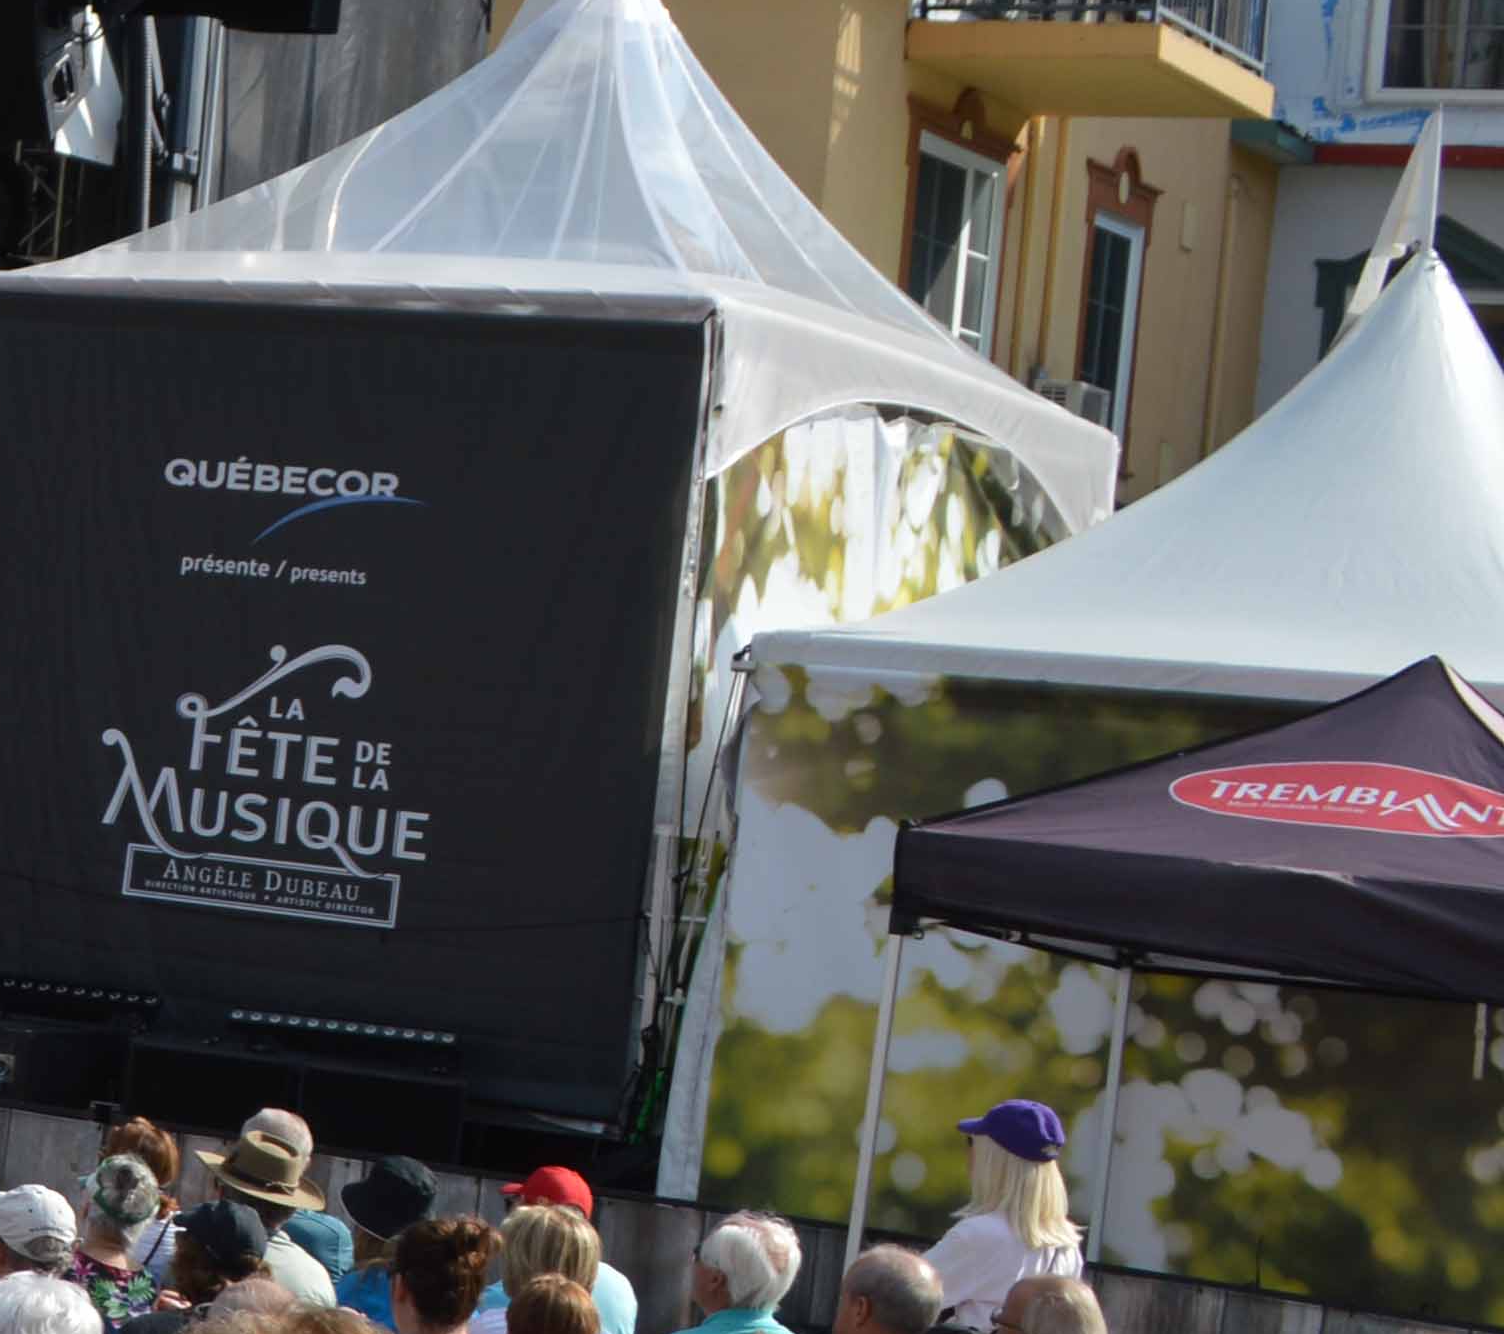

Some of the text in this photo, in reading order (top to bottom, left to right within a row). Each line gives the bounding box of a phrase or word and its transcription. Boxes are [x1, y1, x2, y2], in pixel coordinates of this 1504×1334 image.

[164, 456, 400, 499] QUÉBECOR
[180, 553, 271, 579] présente
[290, 564, 368, 586] presents
[268, 695, 305, 722] LA
[184, 707, 393, 787] FÊTE DE
[102, 727, 431, 870] MUSIQUE
[352, 767, 391, 793] LA
[163, 857, 361, 903] ANGÈLE DUBEAU
